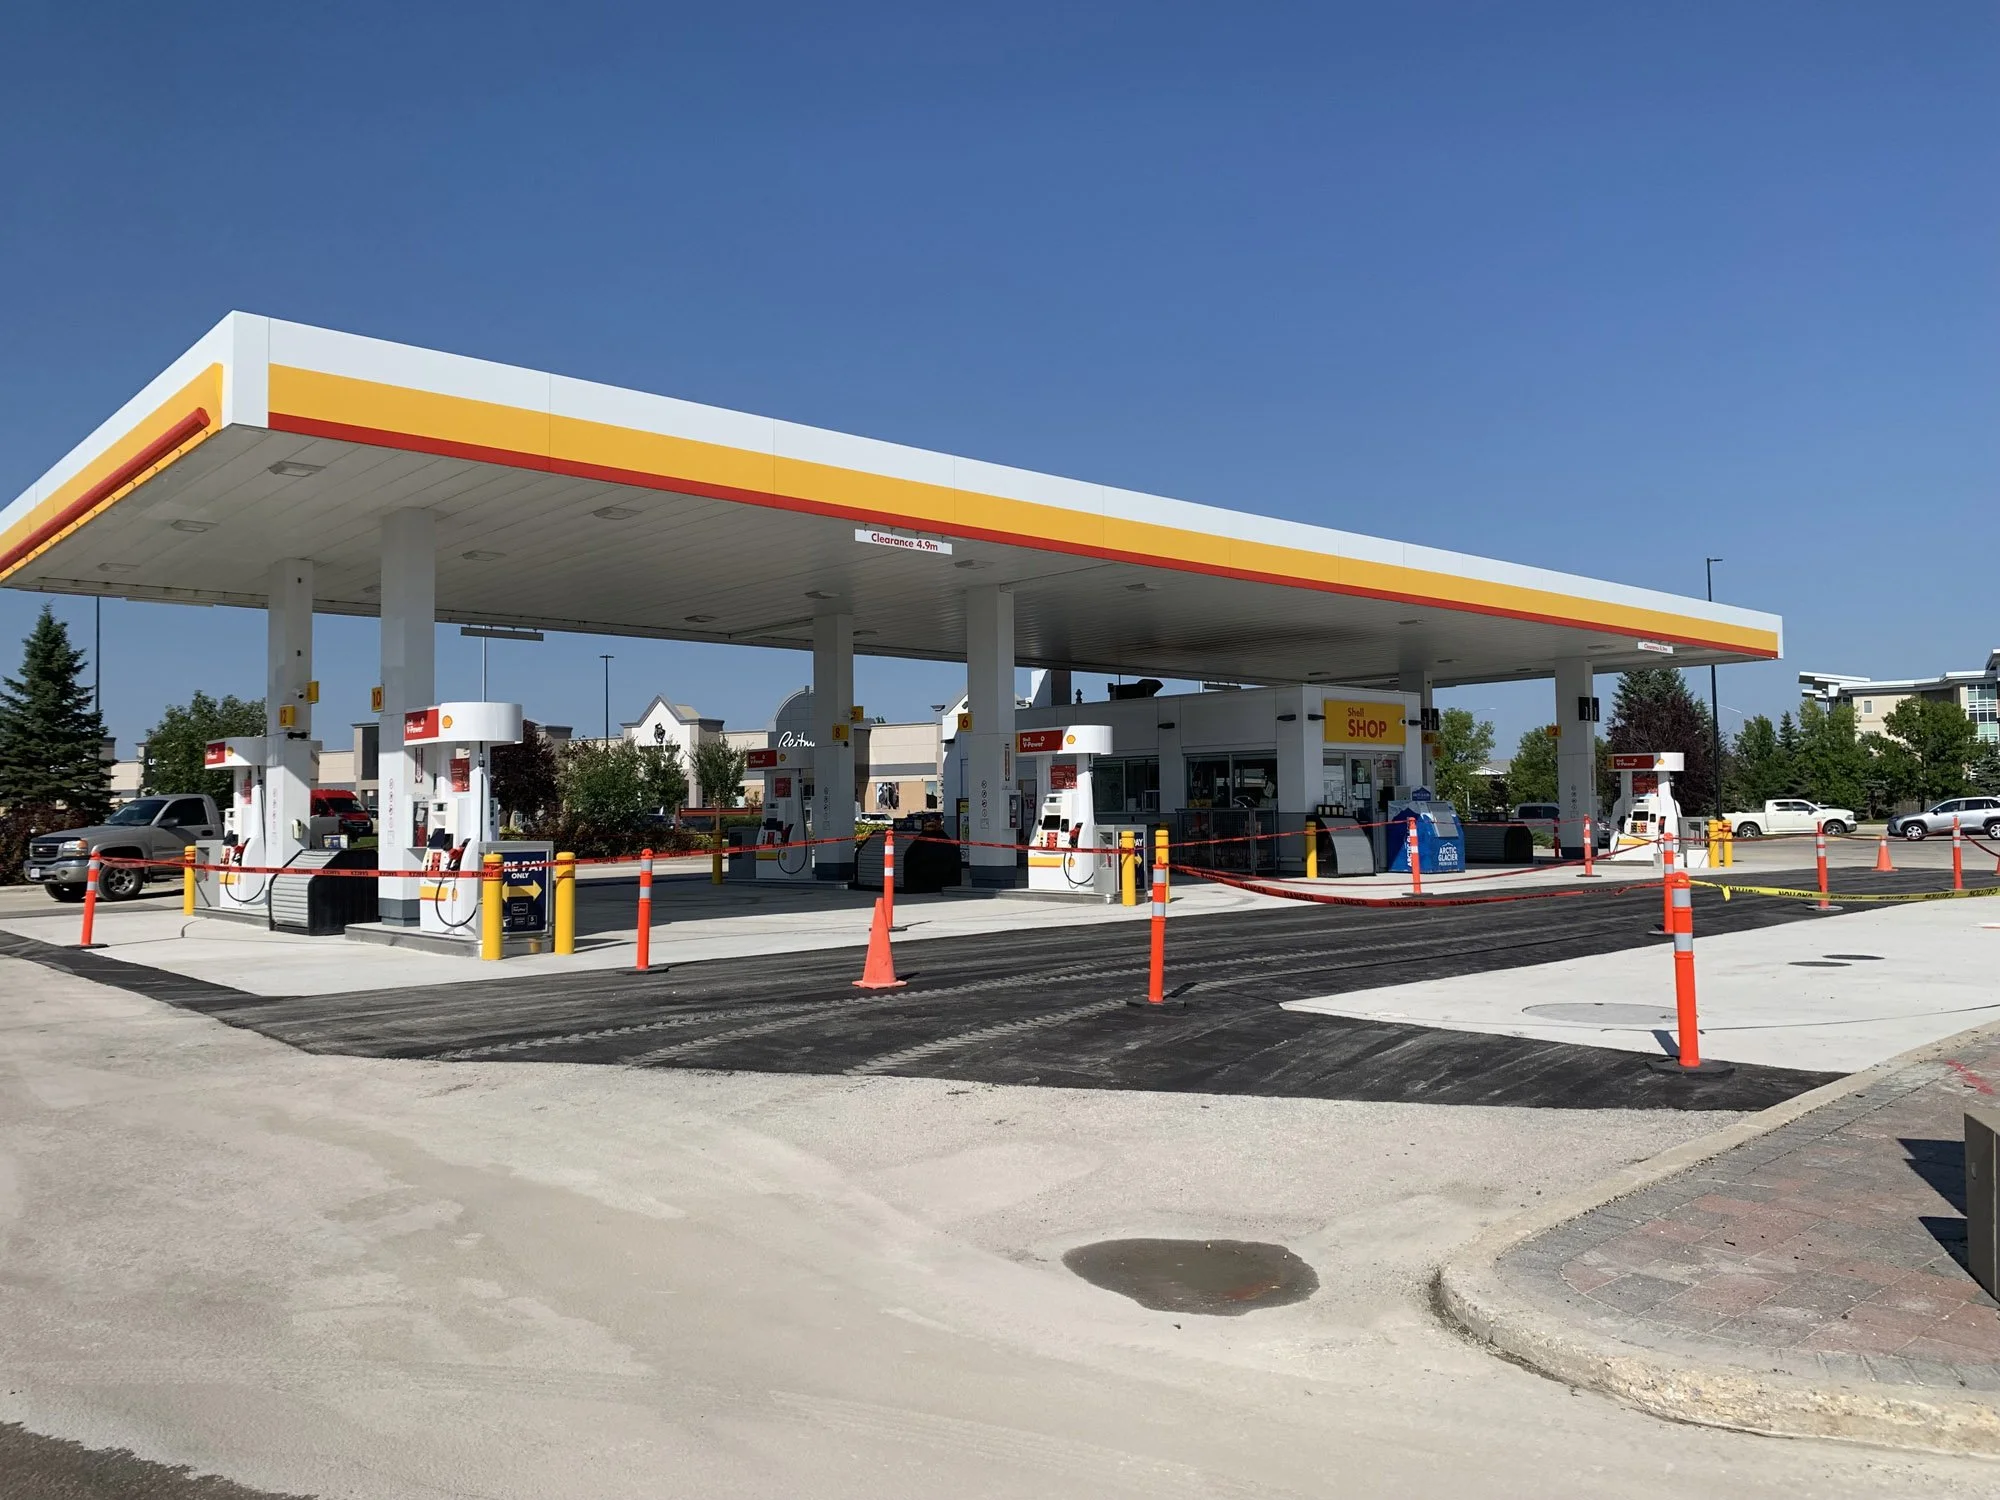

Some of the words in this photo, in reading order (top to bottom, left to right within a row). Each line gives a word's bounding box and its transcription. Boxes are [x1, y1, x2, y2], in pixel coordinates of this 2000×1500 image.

[871, 532, 914, 548] Clearance
[916, 539, 938, 551] 4.9m
[372, 690, 381, 708] 10
[1347, 707, 1364, 717] Shell
[961, 716, 969, 729] 6
[1348, 718, 1387, 738] SHOP
[835, 727, 840, 738] 8
[1440, 846, 1457, 854] ARCTIC
[1438, 853, 1458, 861] GLACIER
[1239, 882, 1266, 894] DANGER
[1283, 890, 1314, 901] DANGER
[1333, 897, 1367, 906] DANGER
[1389, 900, 1426, 908] DANGER
[1968, 888, 1998, 897] CAUTION
